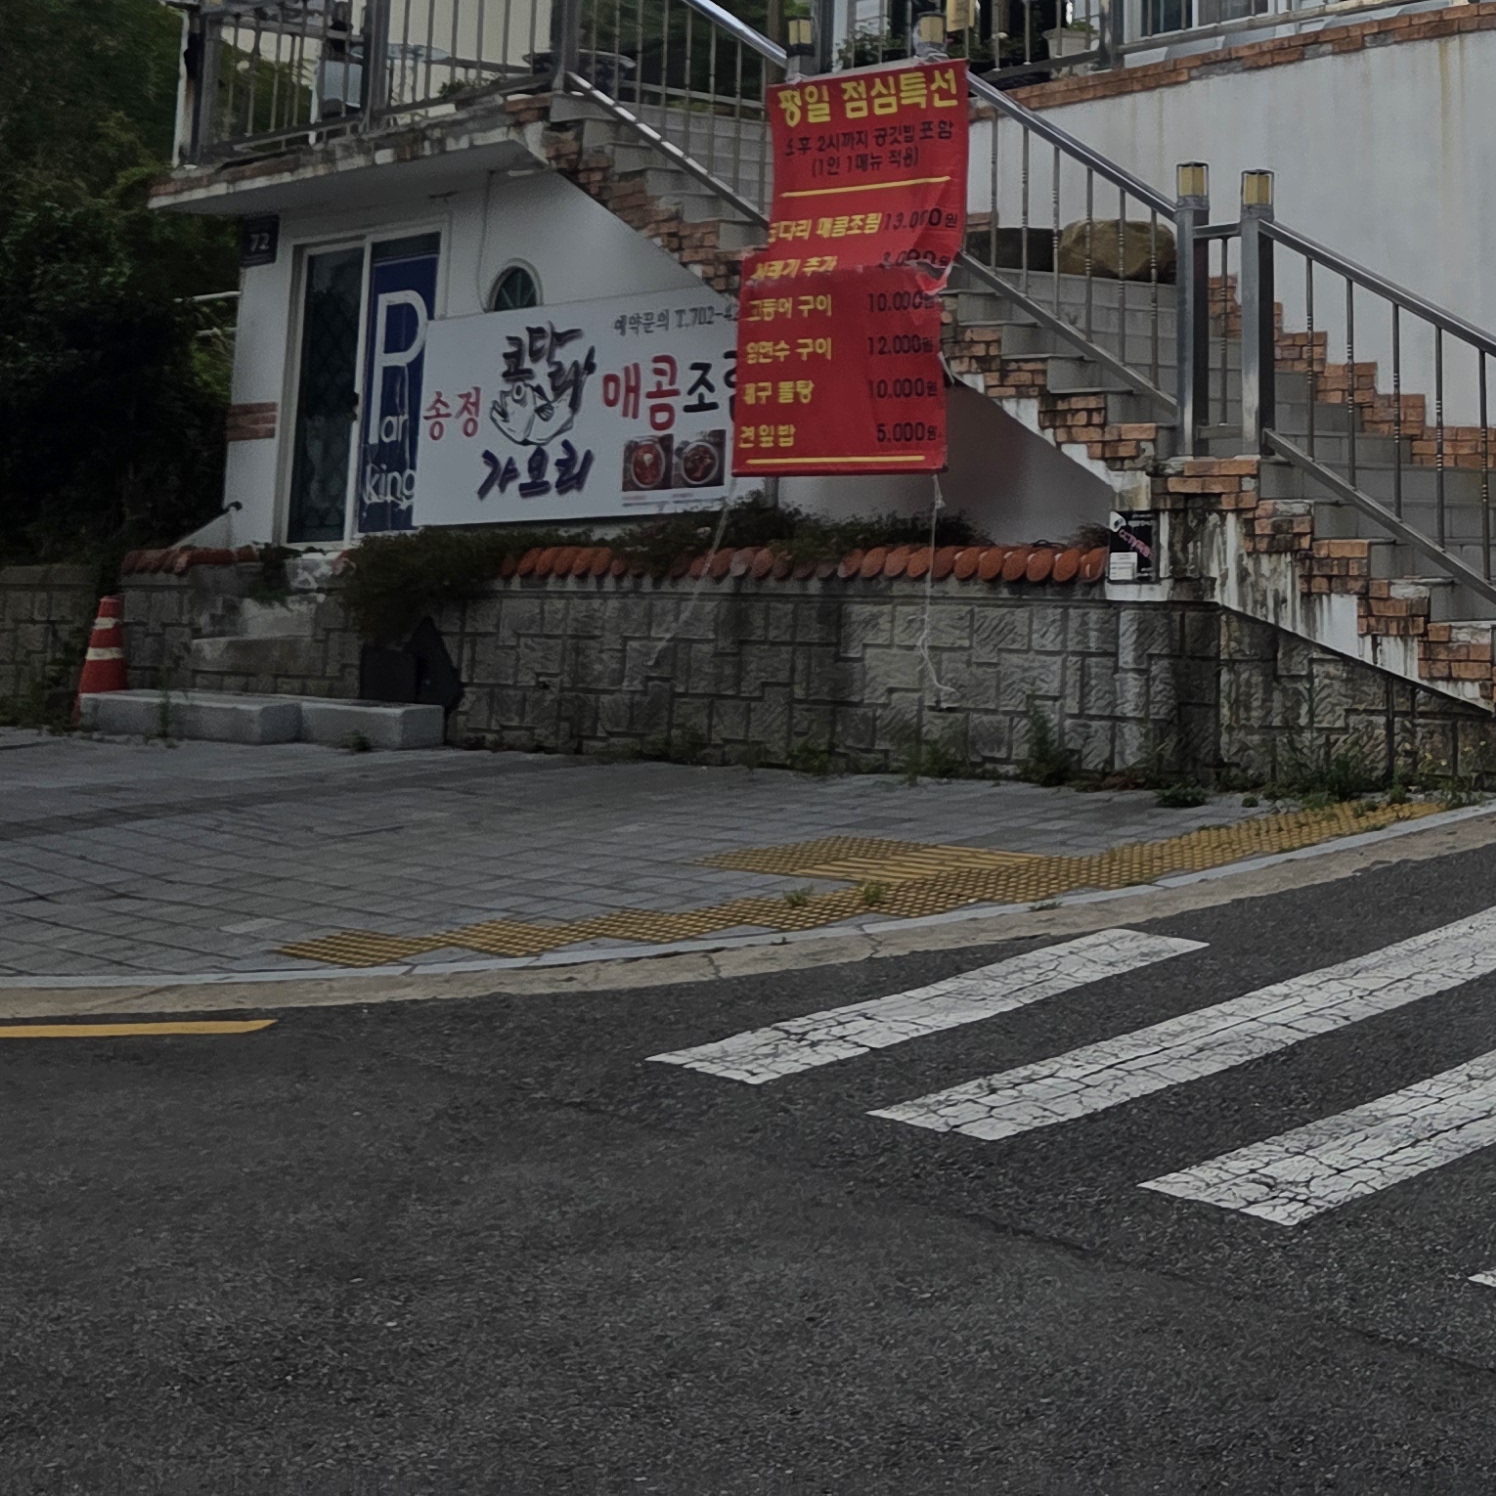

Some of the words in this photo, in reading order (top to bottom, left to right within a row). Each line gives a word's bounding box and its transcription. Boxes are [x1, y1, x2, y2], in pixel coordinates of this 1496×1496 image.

[778, 85, 831, 127] 평일
[817, 129, 869, 153] 2시까지
[919, 119, 954, 140] 포함
[812, 156, 841, 177] (1인
[816, 213, 882, 238] 매콤조림
[797, 294, 832, 318] 구이
[614, 308, 670, 336] 예약문의
[795, 337, 832, 361] 구이
[423, 386, 481, 441] 송정
